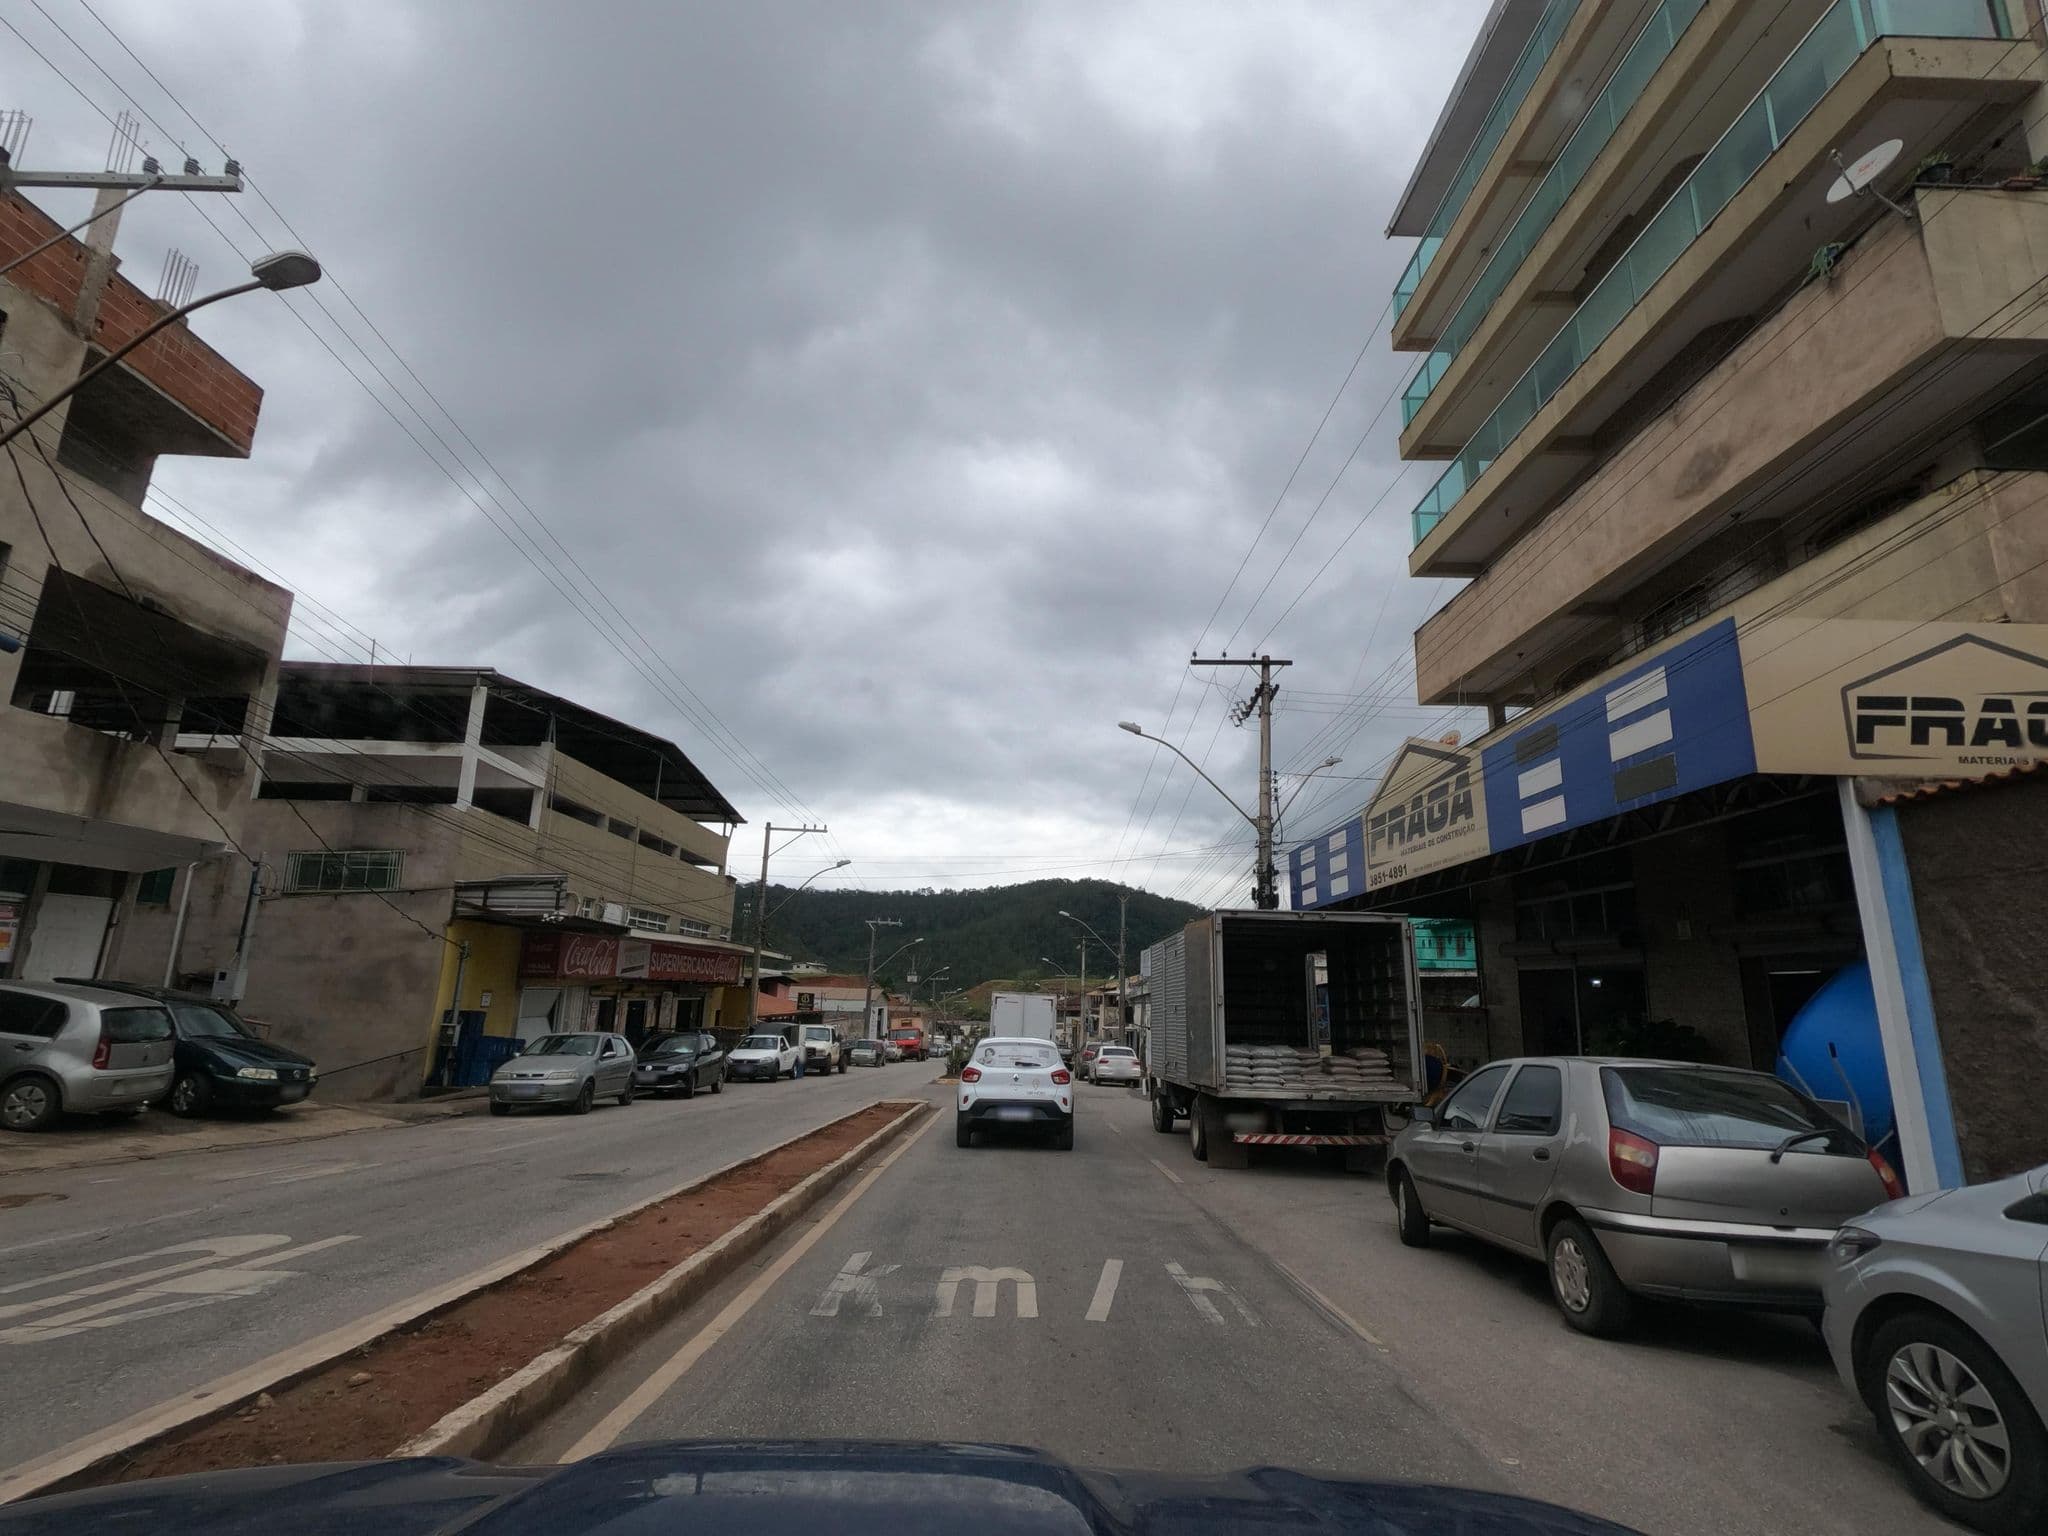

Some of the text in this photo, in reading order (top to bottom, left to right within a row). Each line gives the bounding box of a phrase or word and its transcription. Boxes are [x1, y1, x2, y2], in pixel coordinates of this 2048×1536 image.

[1370, 771, 1474, 858] FRAGA
[1436, 822, 1476, 846] CONSTRUÇÃO
[1369, 863, 1409, 888] 3851-4891
[650, 951, 715, 977] SUPERMERCADOS
